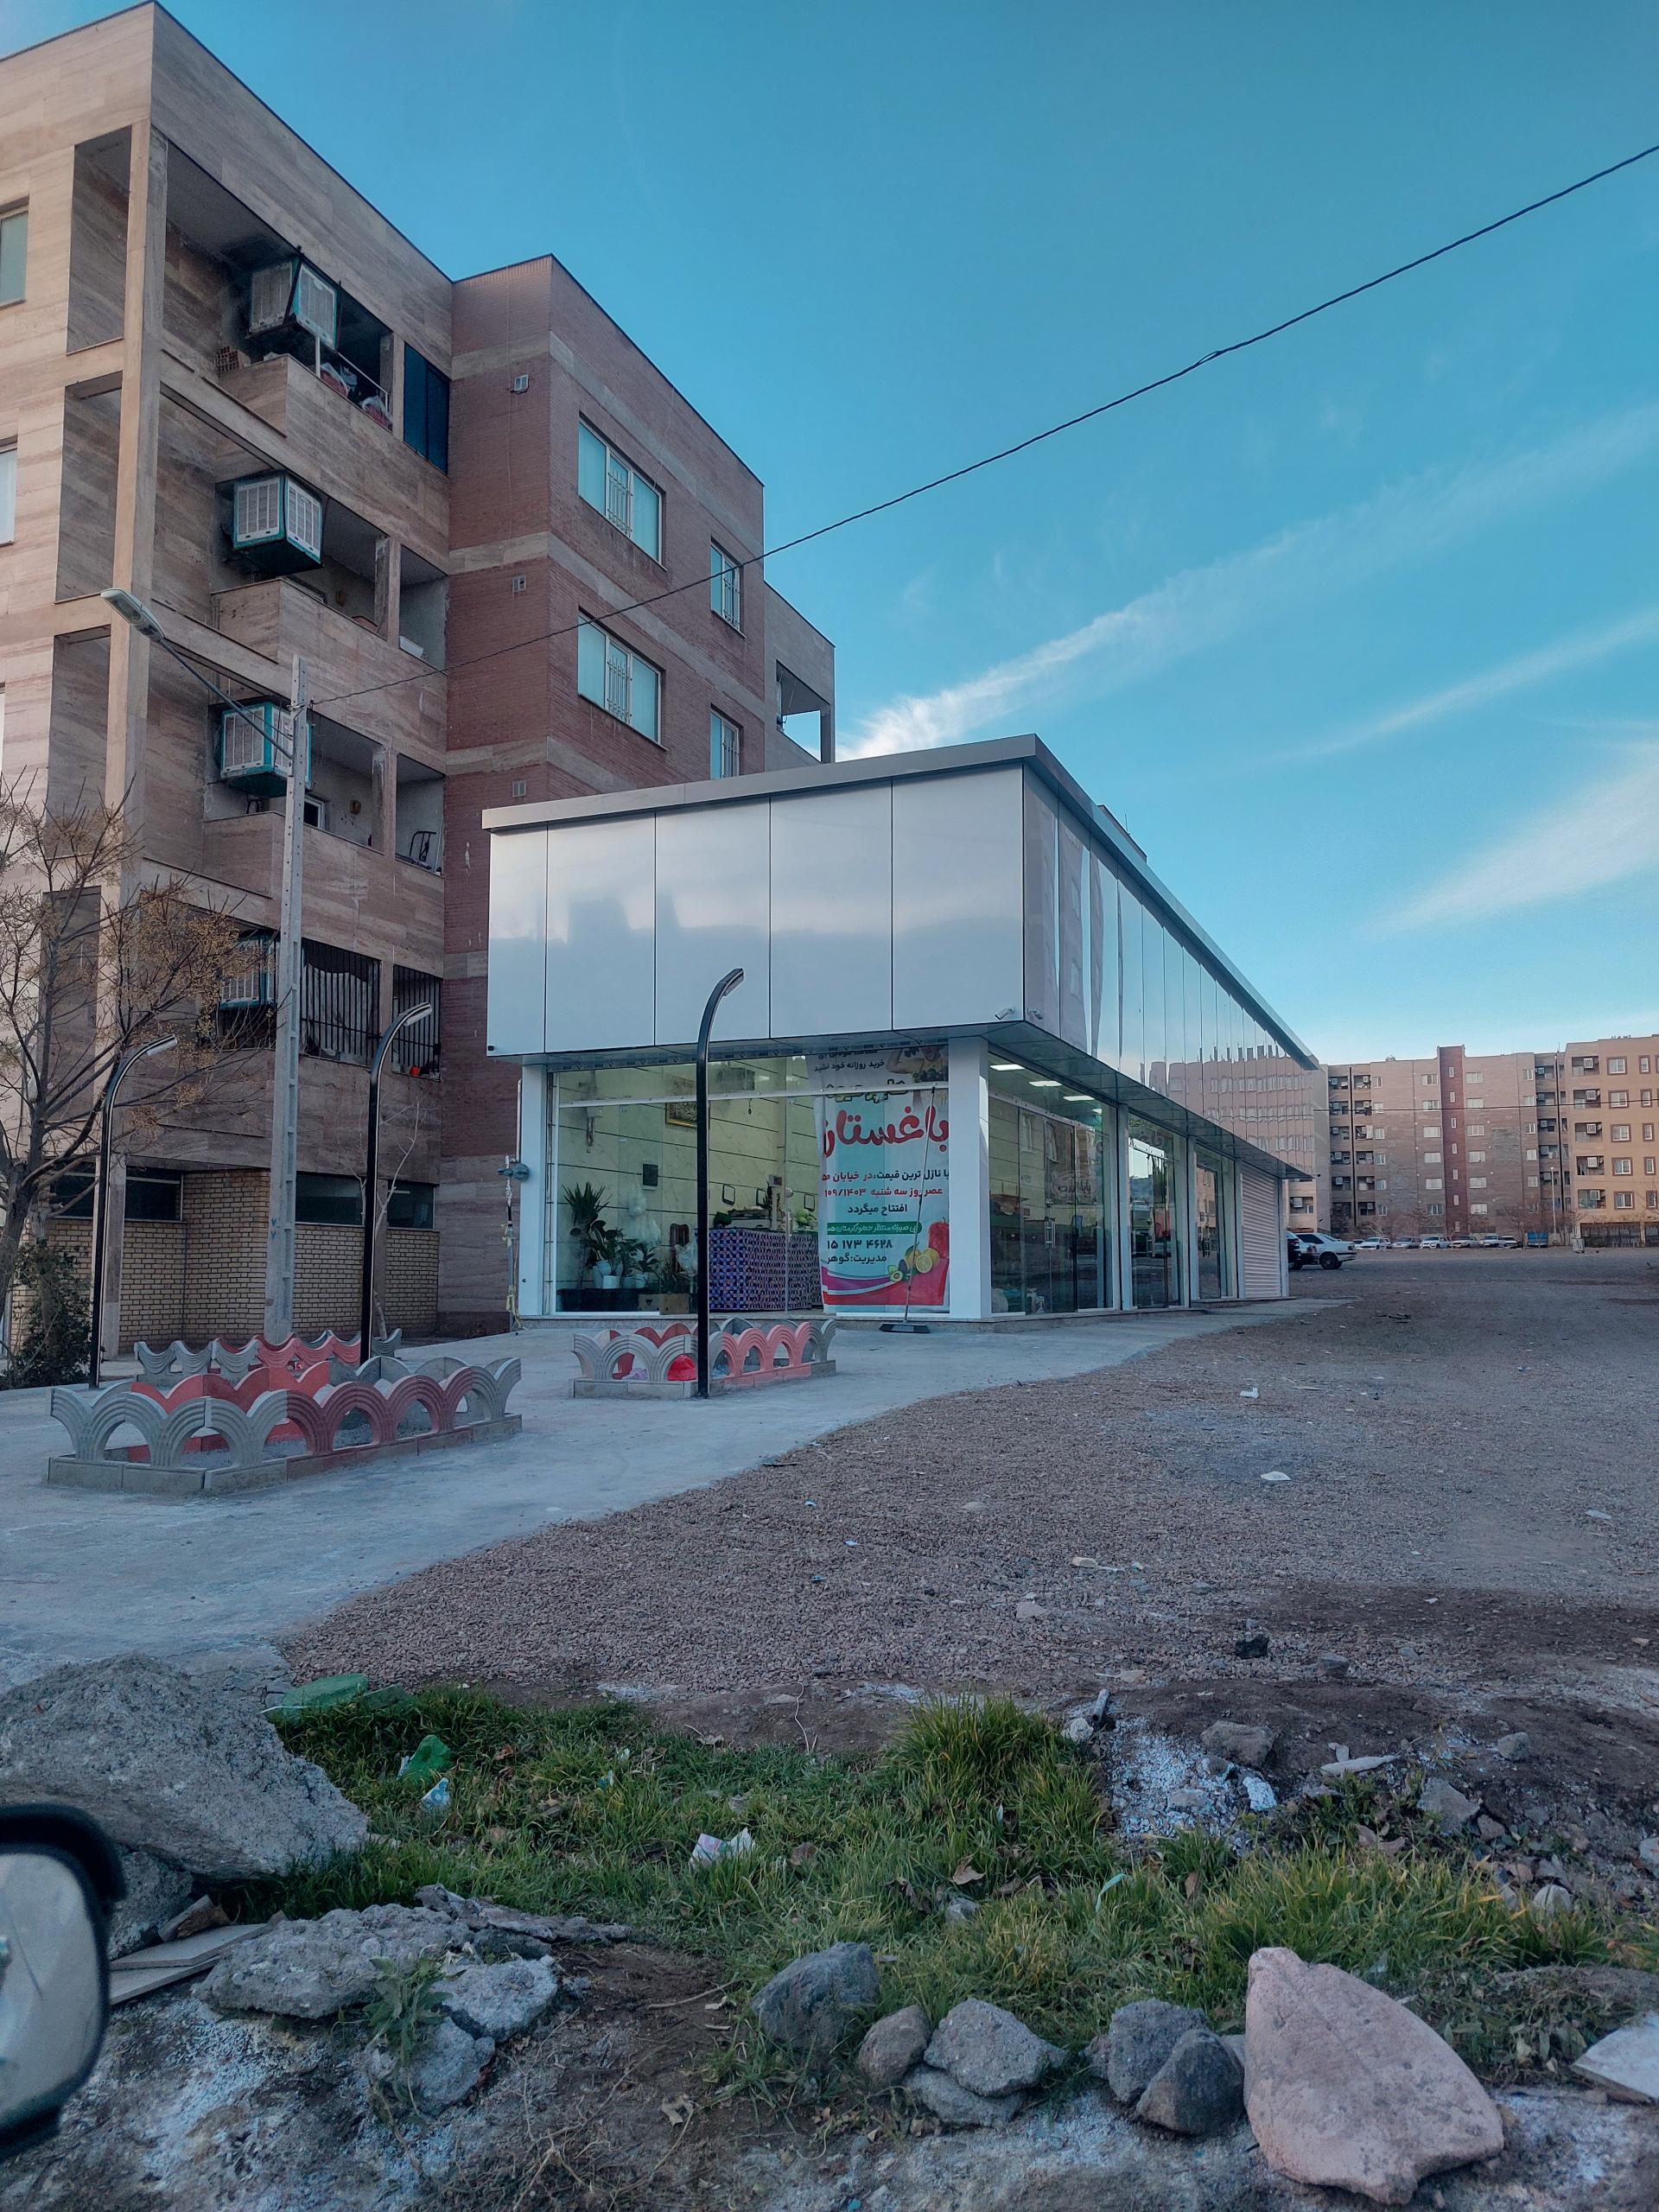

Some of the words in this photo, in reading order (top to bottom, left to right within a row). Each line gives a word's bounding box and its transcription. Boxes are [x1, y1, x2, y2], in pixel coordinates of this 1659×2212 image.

[847, 1061, 867, 1071] روزانه
[868, 1059, 885, 1069] خرید
[833, 1171, 859, 1183] خیابان
[902, 1171, 921, 1180] ترین
[870, 1186, 892, 1197] شنبه
[924, 1188, 943, 1198] عصر
[848, 1204, 879, 1216] میگردد
[881, 1204, 907, 1216] افتتاح
